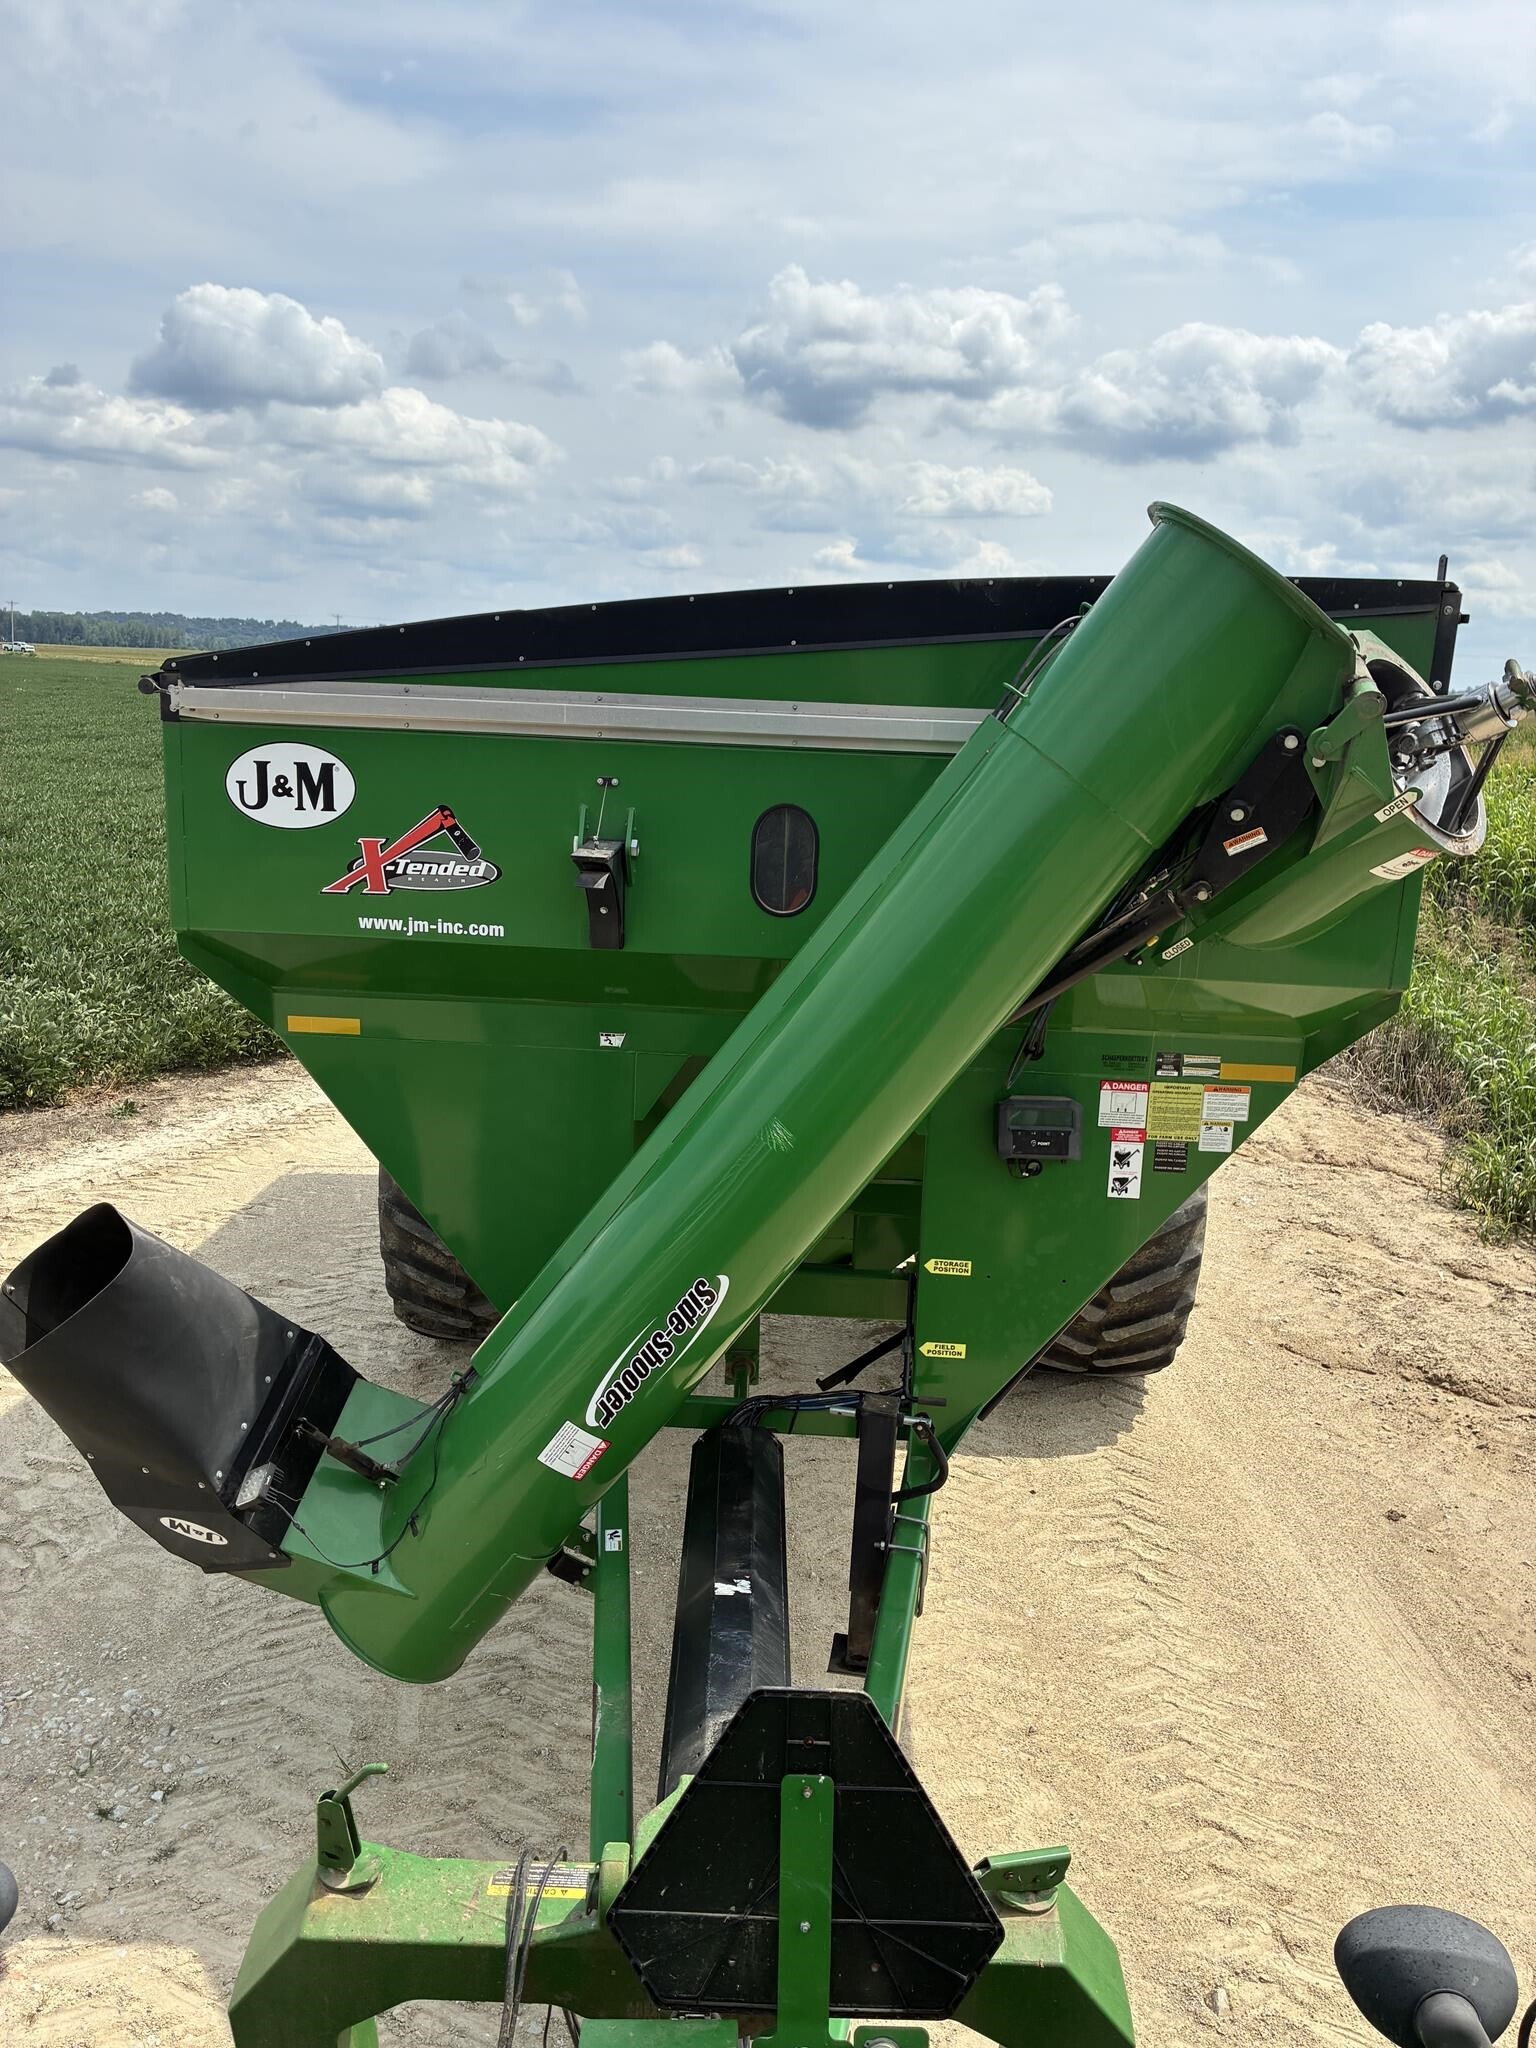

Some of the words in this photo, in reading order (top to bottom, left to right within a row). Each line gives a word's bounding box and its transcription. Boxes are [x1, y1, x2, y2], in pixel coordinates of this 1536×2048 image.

[236, 760, 337, 812] J&M
[1382, 797, 1409, 817] OPEN
[1233, 829, 1261, 847] WARNING
[358, 916, 505, 937] www.jm-inc.com
[1164, 939, 1191, 959] CLOSED
[1112, 1082, 1148, 1092] DANGER
[933, 1266, 970, 1274] POSITION
[934, 1260, 969, 1268] STORAGE
[597, 1278, 718, 1428] Side-Shooter
[926, 1349, 963, 1357] POSITION
[934, 1343, 956, 1351] FIELD
[575, 1450, 602, 1479] DANGER
[168, 1518, 223, 1542] J&M
